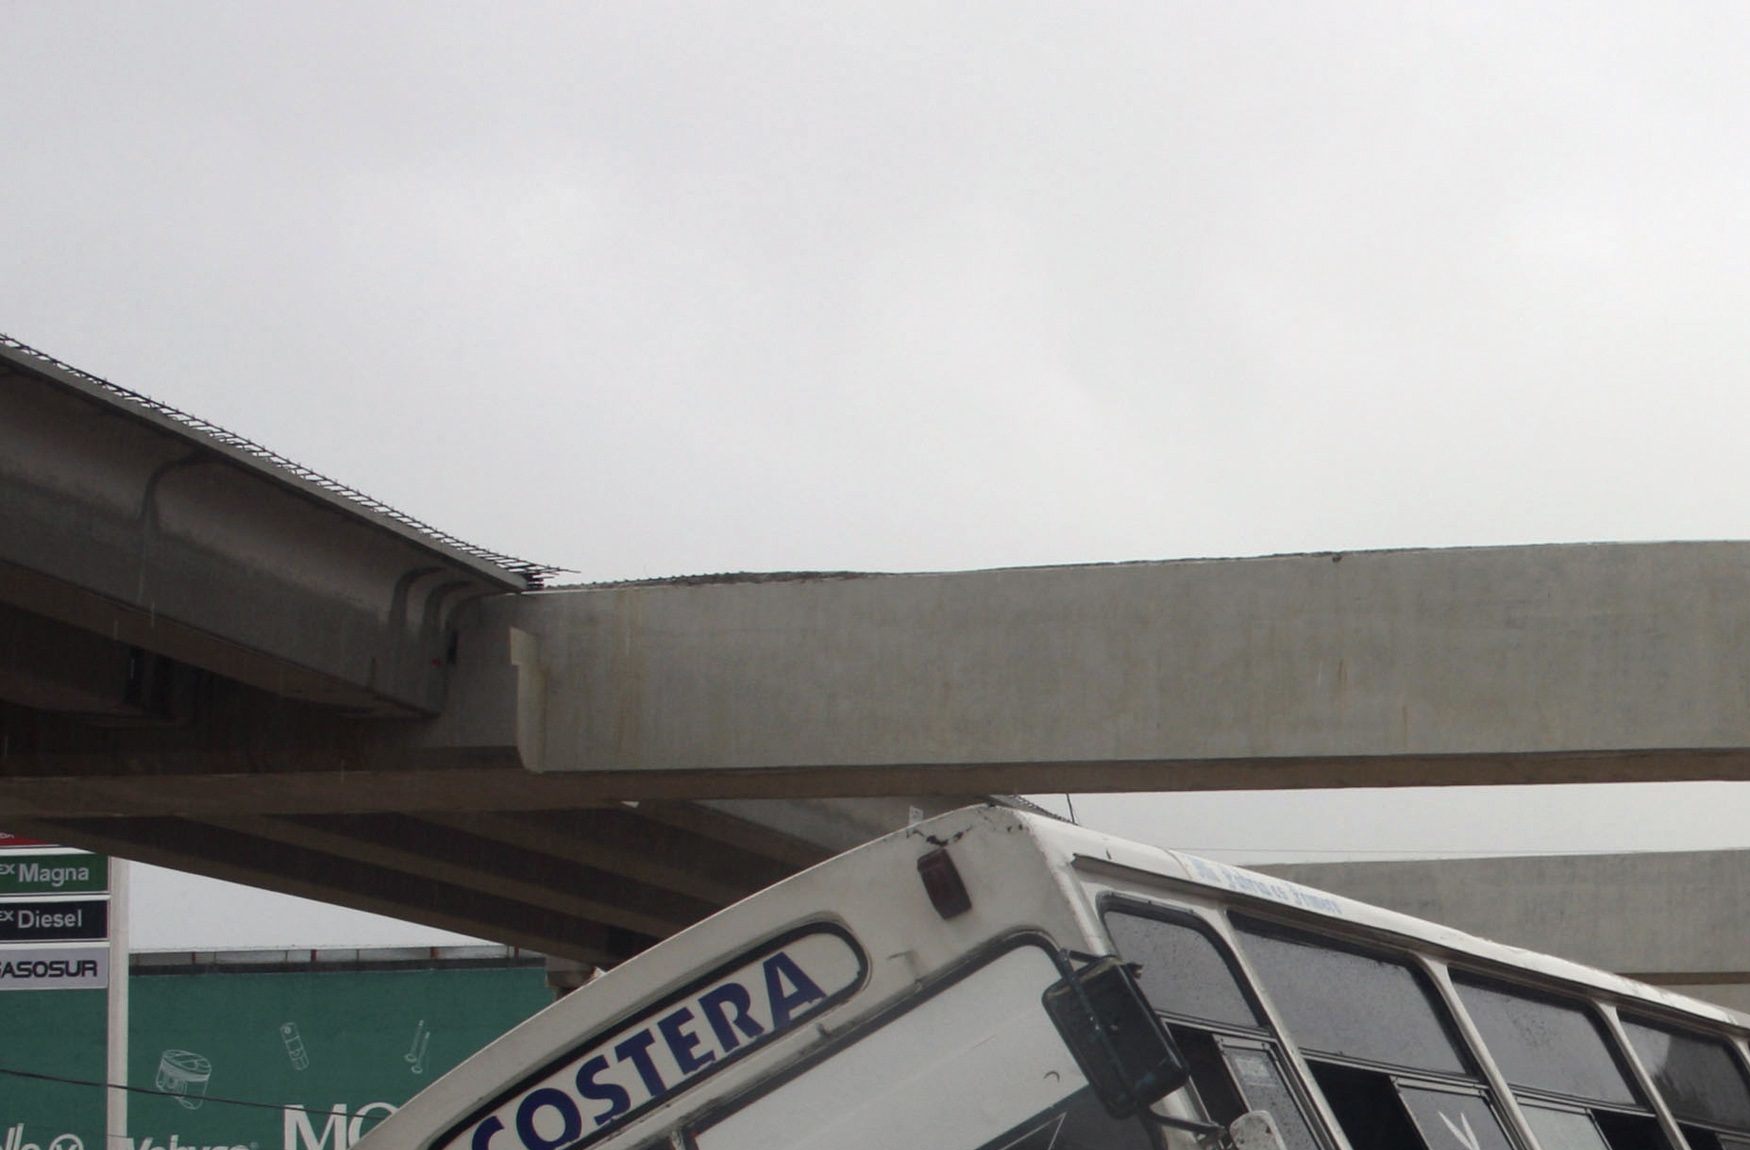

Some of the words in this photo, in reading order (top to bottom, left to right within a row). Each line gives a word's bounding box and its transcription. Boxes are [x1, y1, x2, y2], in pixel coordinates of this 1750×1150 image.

[18, 863, 89, 887] Magna
[18, 909, 82, 928] Diesel
[0, 960, 97, 979] ASOSUR
